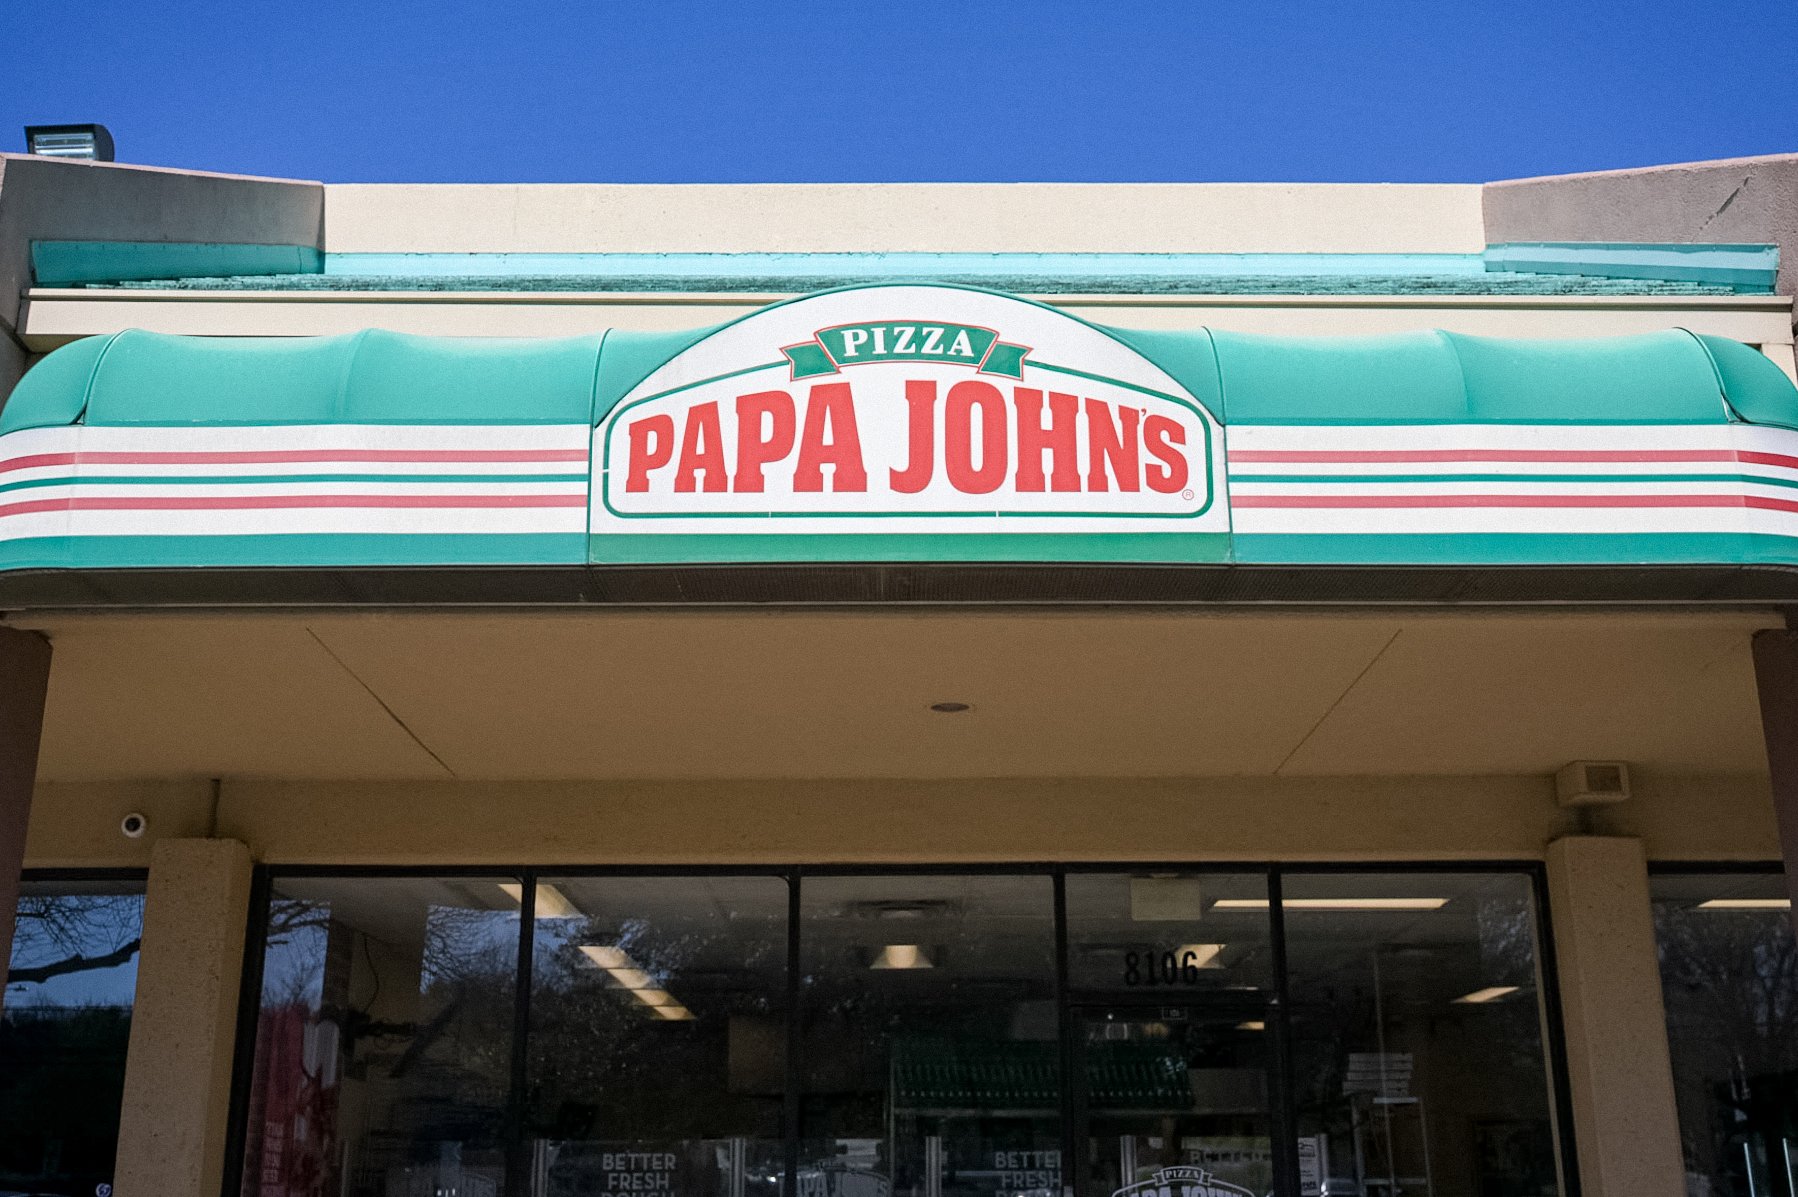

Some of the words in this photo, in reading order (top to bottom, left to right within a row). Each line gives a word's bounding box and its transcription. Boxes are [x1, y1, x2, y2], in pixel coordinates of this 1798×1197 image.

[841, 325, 975, 358] PIZZA
[625, 381, 868, 493] PAPA
[889, 379, 1189, 494] JOHN'S
[1126, 951, 1198, 985] 8106
[602, 1153, 676, 1170] BETTER
[607, 1172, 670, 1190] FRESH
[1001, 1171, 1062, 1188] FRESH
[1164, 1168, 1200, 1180] PIZZA
